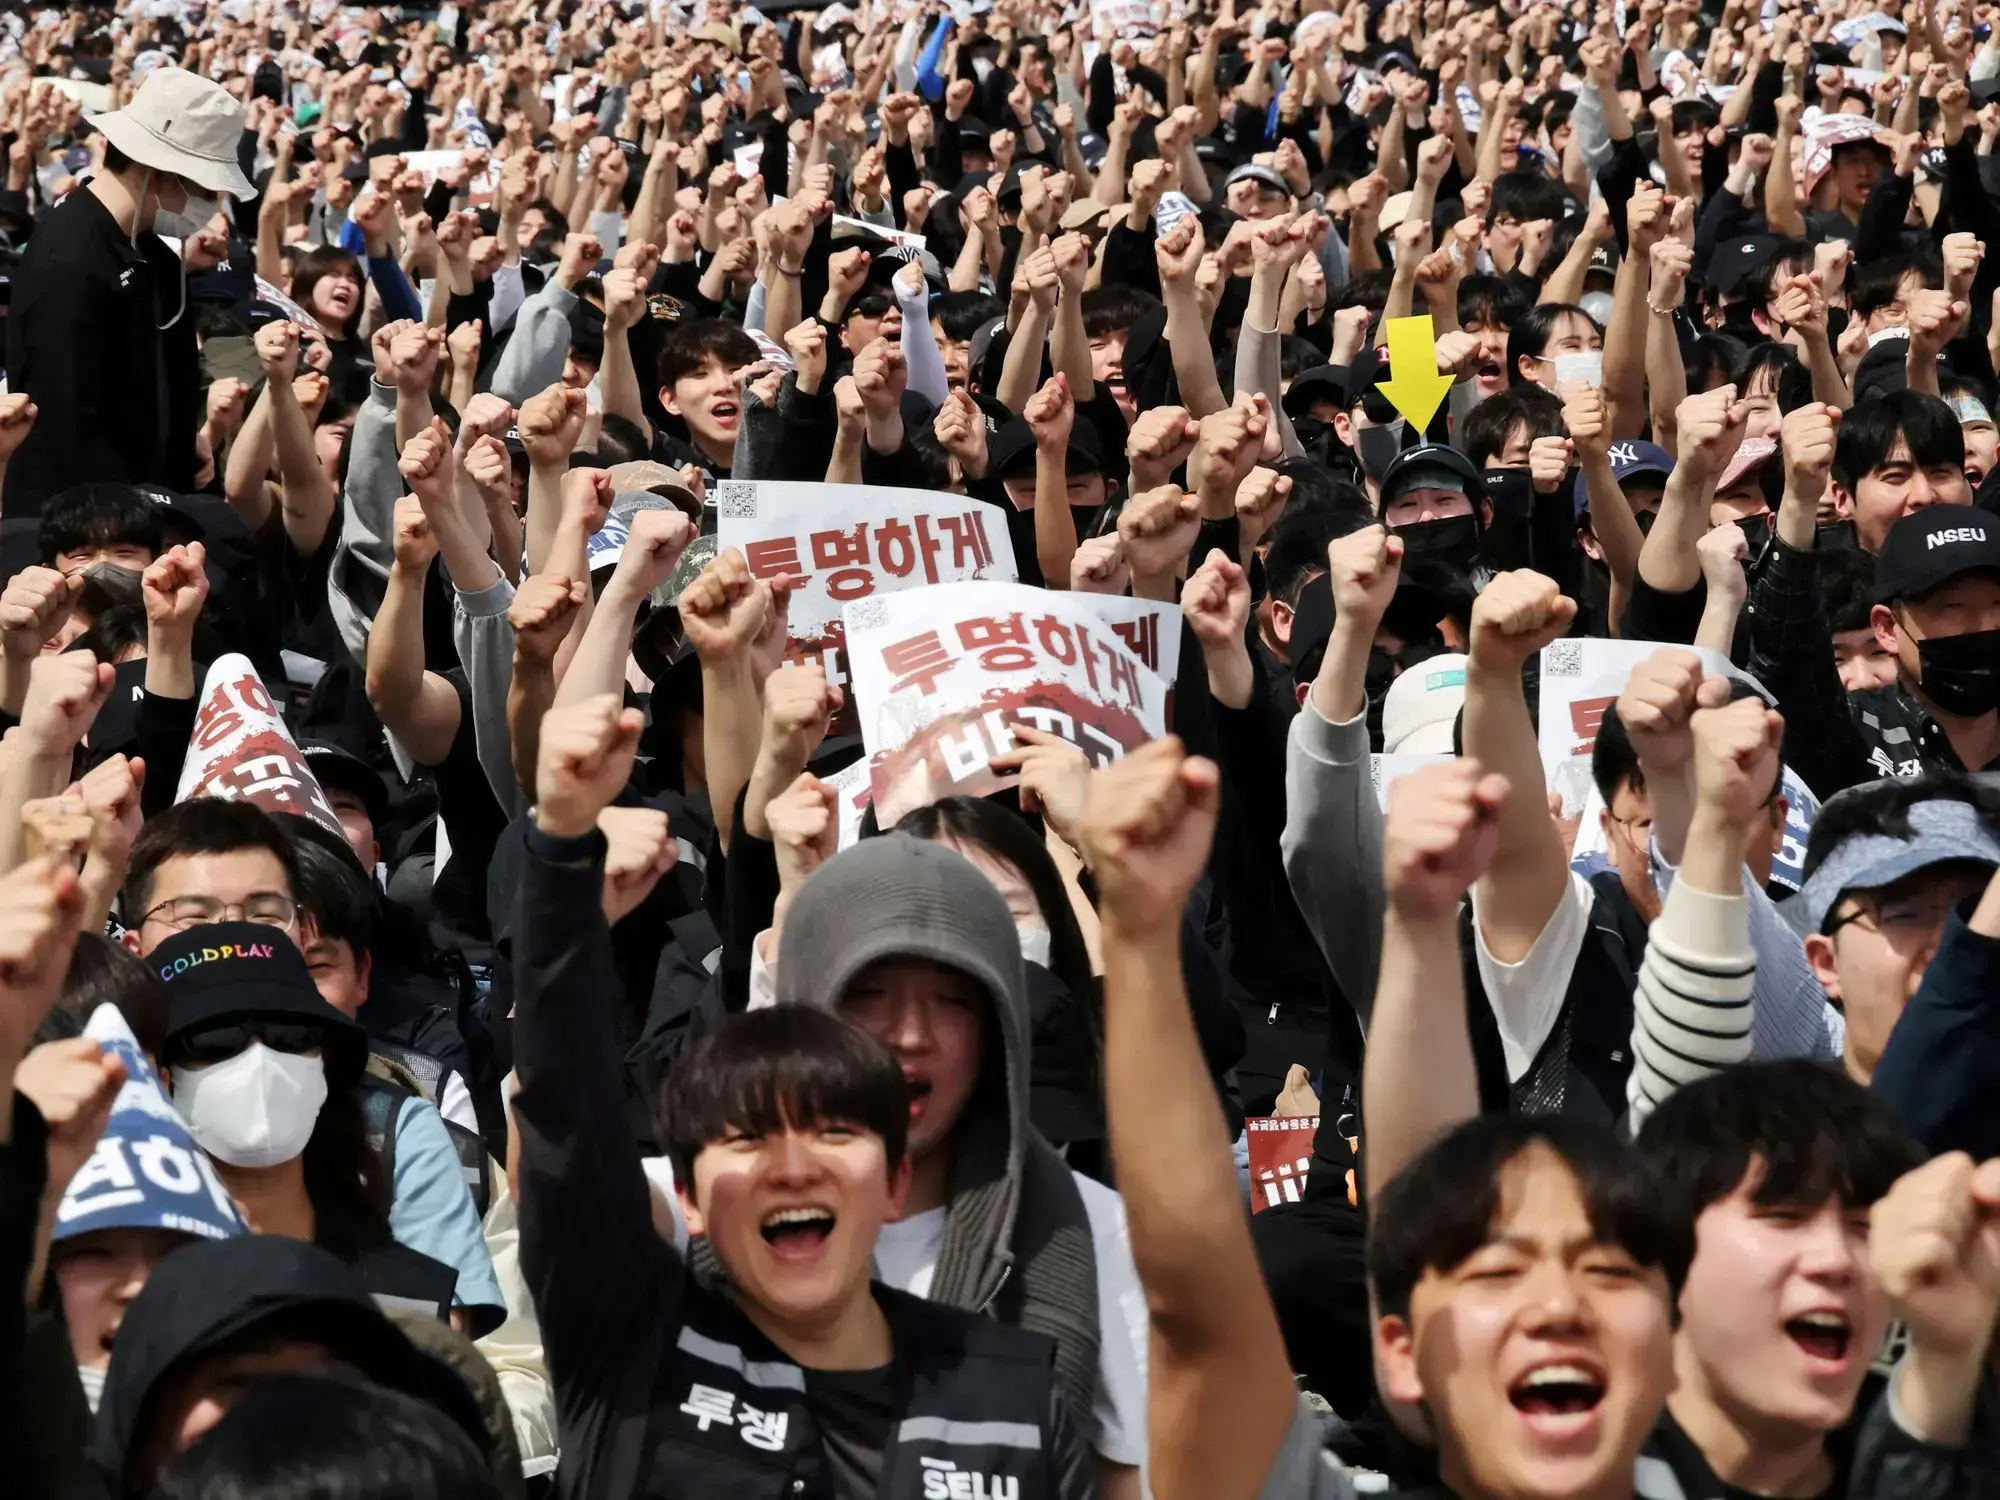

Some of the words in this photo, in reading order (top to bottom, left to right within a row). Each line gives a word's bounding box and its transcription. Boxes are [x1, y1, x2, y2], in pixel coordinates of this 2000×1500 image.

[745, 510, 994, 602] 투명하게
[1926, 527, 1987, 550] NSEU
[880, 611, 1144, 710] 투명하게
[160, 943, 274, 982] COLDPLAY
[679, 1382, 789, 1452] 투쟁
